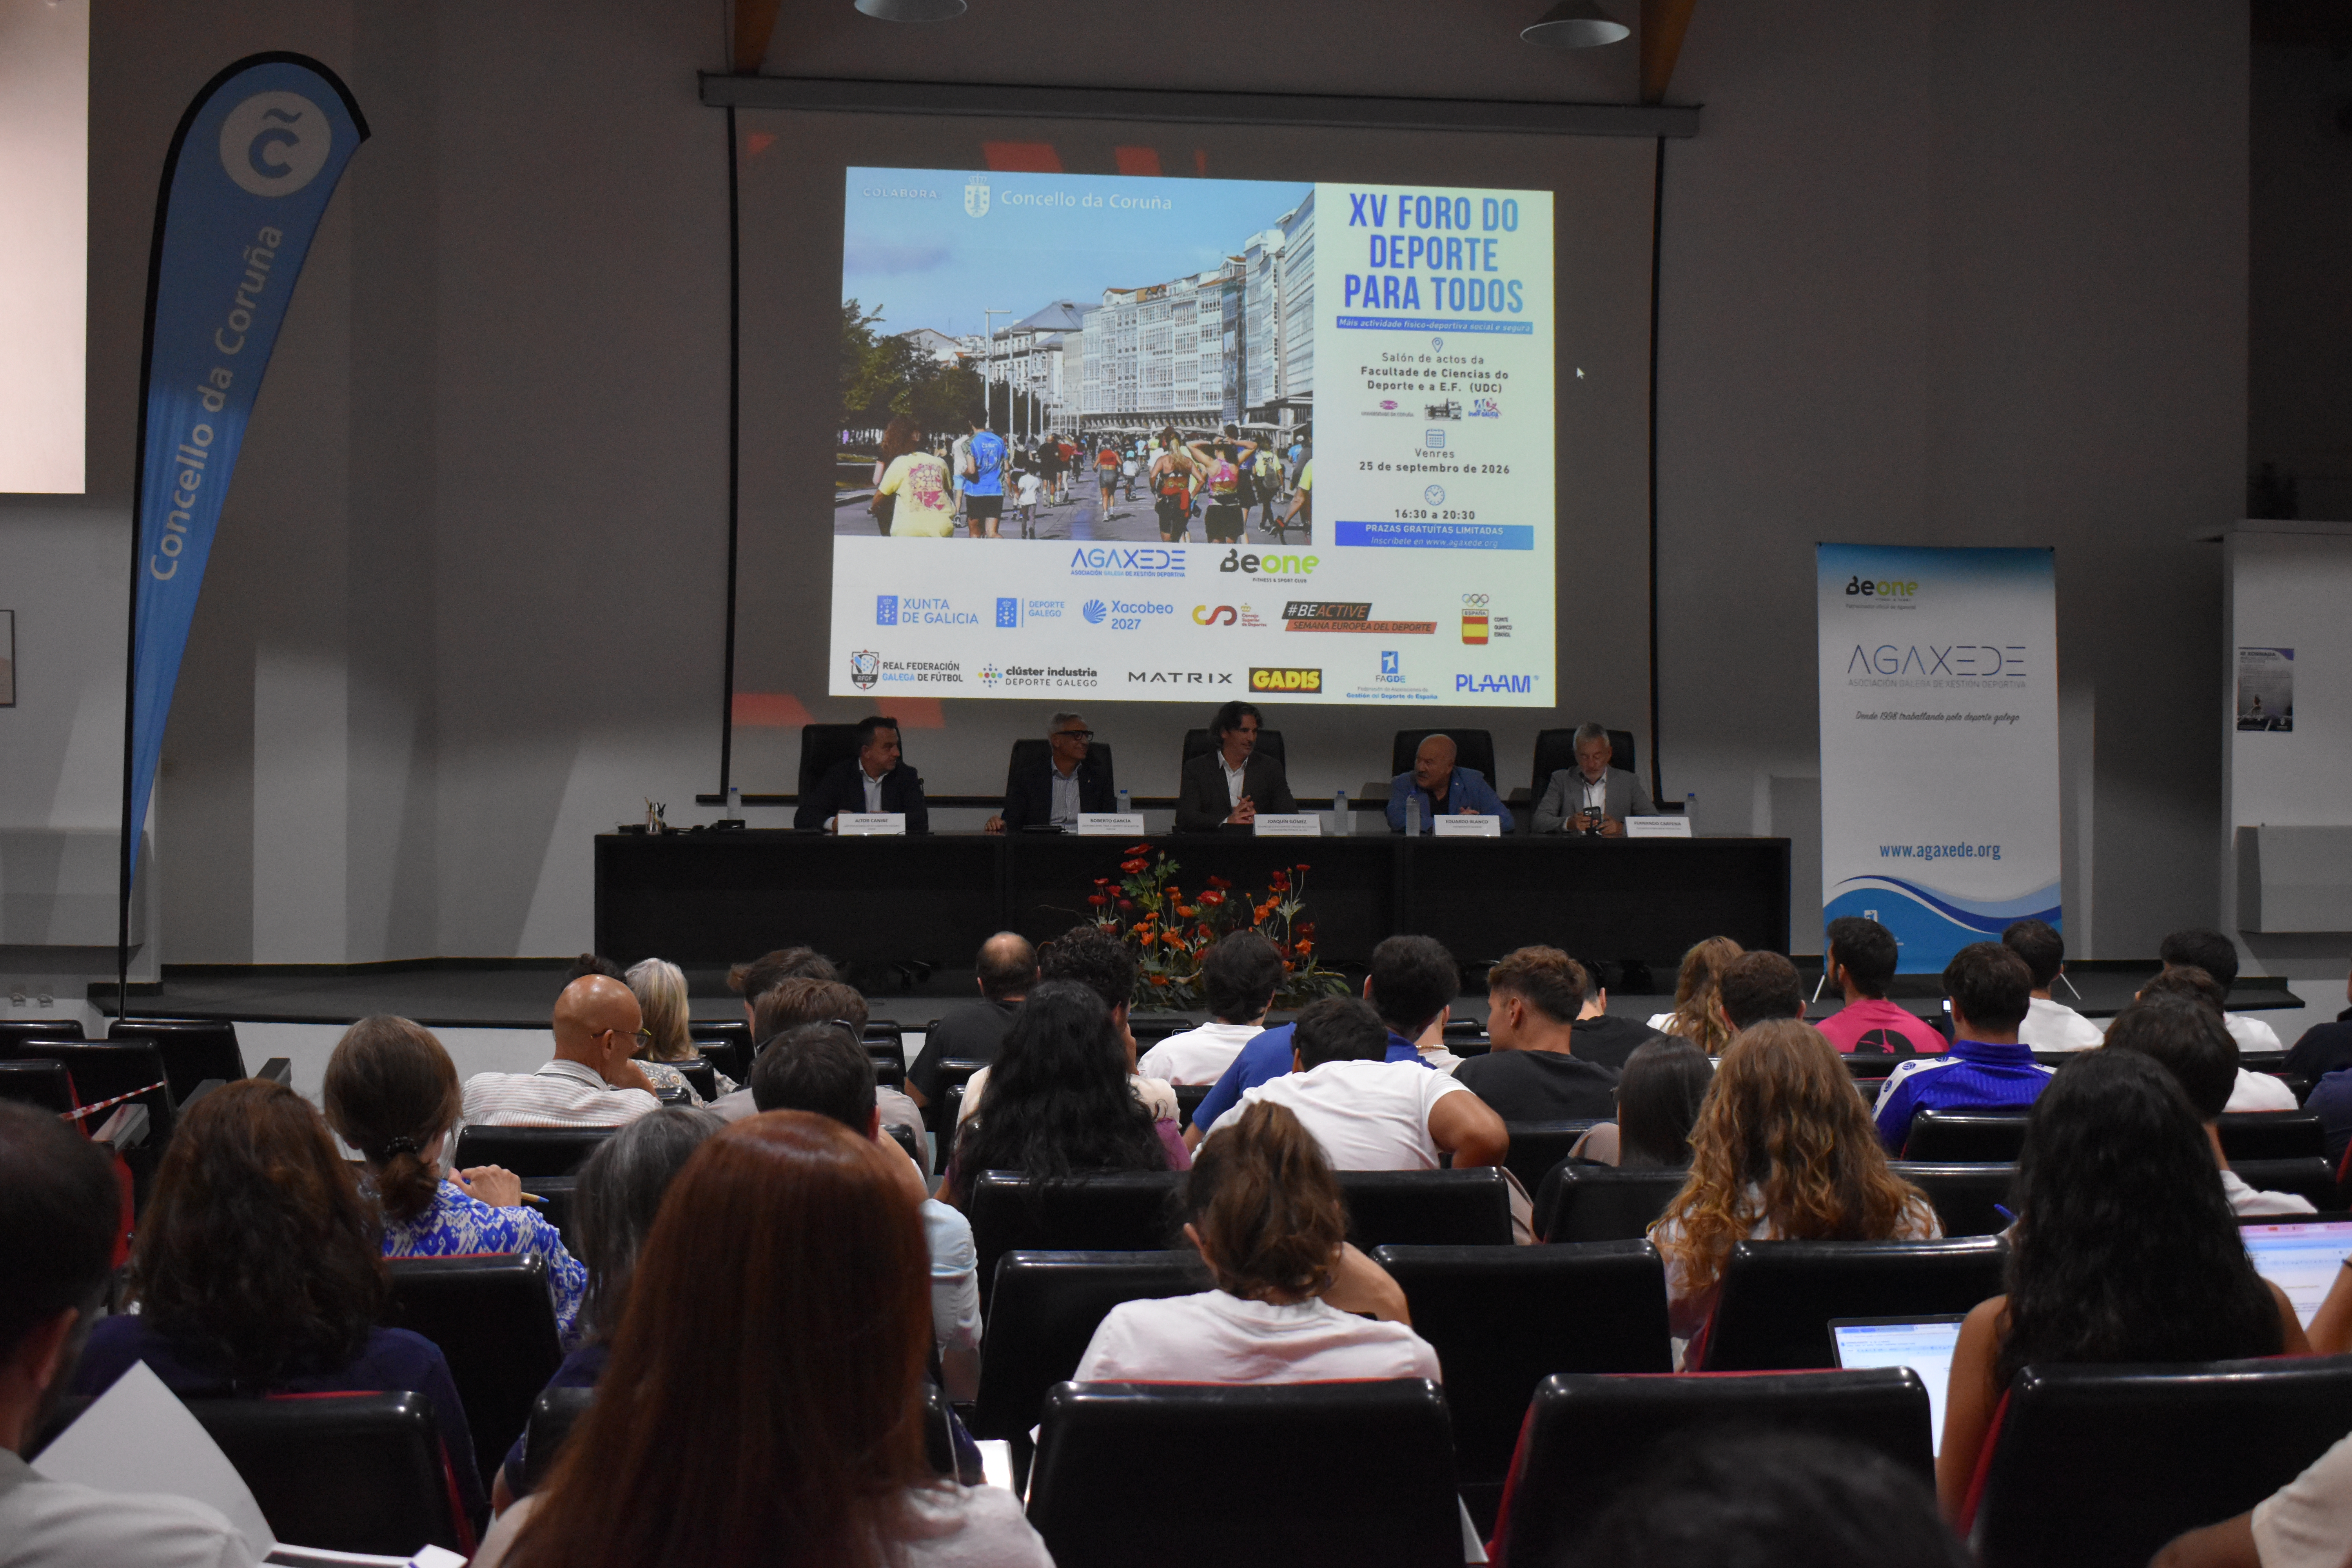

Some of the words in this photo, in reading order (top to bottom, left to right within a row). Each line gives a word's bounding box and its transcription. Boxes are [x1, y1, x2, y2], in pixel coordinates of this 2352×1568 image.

[1002, 191, 1075, 207] Concello
[1082, 192, 1103, 207] da
[1109, 193, 1172, 210] Coruña
[1349, 193, 1388, 227] XV
[1399, 195, 1471, 230] FORO
[1483, 198, 1519, 232] DO
[1370, 234, 1498, 272] DEPORTE
[215, 226, 283, 355] Coruña
[1345, 274, 1421, 310] PARA
[1430, 277, 1523, 313] TODOS
[1339, 318, 1358, 327] Máis
[1360, 319, 1402, 328] actividade
[1503, 325, 1530, 334] segura
[1382, 352, 1414, 363] Salón
[1419, 354, 1431, 363] de
[1436, 355, 1466, 364] actos
[1471, 355, 1484, 365] da
[1361, 366, 1419, 377] Facultade
[1423, 368, 1437, 377] de
[1441, 368, 1490, 379] Ciencias
[1495, 371, 1508, 379] do
[198, 366, 234, 412] da
[1367, 380, 1414, 391] Deporte
[1440, 383, 1462, 392] E.F.
[1470, 383, 1502, 393] (UDC)
[1415, 448, 1455, 458] Venres
[1360, 462, 1373, 470] 25
[1378, 462, 1391, 471] de
[1396, 463, 1459, 473] septembro
[1463, 464, 1477, 473] de
[1481, 465, 1510, 474] 2026
[151, 423, 214, 582] Concello
[1395, 509, 1427, 519] 16:30
[1443, 510, 1475, 520] 20:30
[1366, 524, 1401, 533] PRAZAS
[1404, 523, 1454, 534] GRATUÍTAS
[1456, 526, 1503, 535] LIMITADAS
[1426, 538, 1498, 548] www.agaxede.org
[1071, 548, 1185, 570] AGAXEDE
[903, 598, 949, 610] XUNTA
[1112, 600, 1173, 614] Xacobeo
[902, 612, 921, 622] DE
[924, 613, 979, 624] GALICIA
[1029, 609, 1061, 617] GALEGO
[1111, 618, 1141, 630] 2027
[1293, 622, 1331, 630] SEMANA
[1332, 622, 1372, 632] EUROPEA
[1374, 622, 1390, 632] DEL
[1392, 623, 1432, 632] DEPORTE
[883, 662, 904, 670] REAL
[907, 661, 959, 671] FEDERACIÓN
[1847, 644, 2026, 676] AGAXEDE
[882, 673, 915, 681] GALEGA
[931, 671, 963, 682] FÚTBOL
[1005, 666, 1045, 677] clúster
[1047, 667, 1097, 677] industria
[1129, 672, 1233, 683] MATRIX
[1252, 670, 1320, 688] GADIS
[1848, 678, 1896, 687] ASOCIACIÓN
[1899, 680, 1931, 688] GALEGA
[1945, 679, 1979, 688] XESTIÓN
[1880, 711, 1898, 720] 1998
[1899, 712, 1944, 720] traballando
[1945, 713, 1962, 723] polo
[1964, 713, 1992, 723] deporte
[1994, 713, 2020, 725] galego
[1880, 842, 2001, 861] www.agaxede.org
